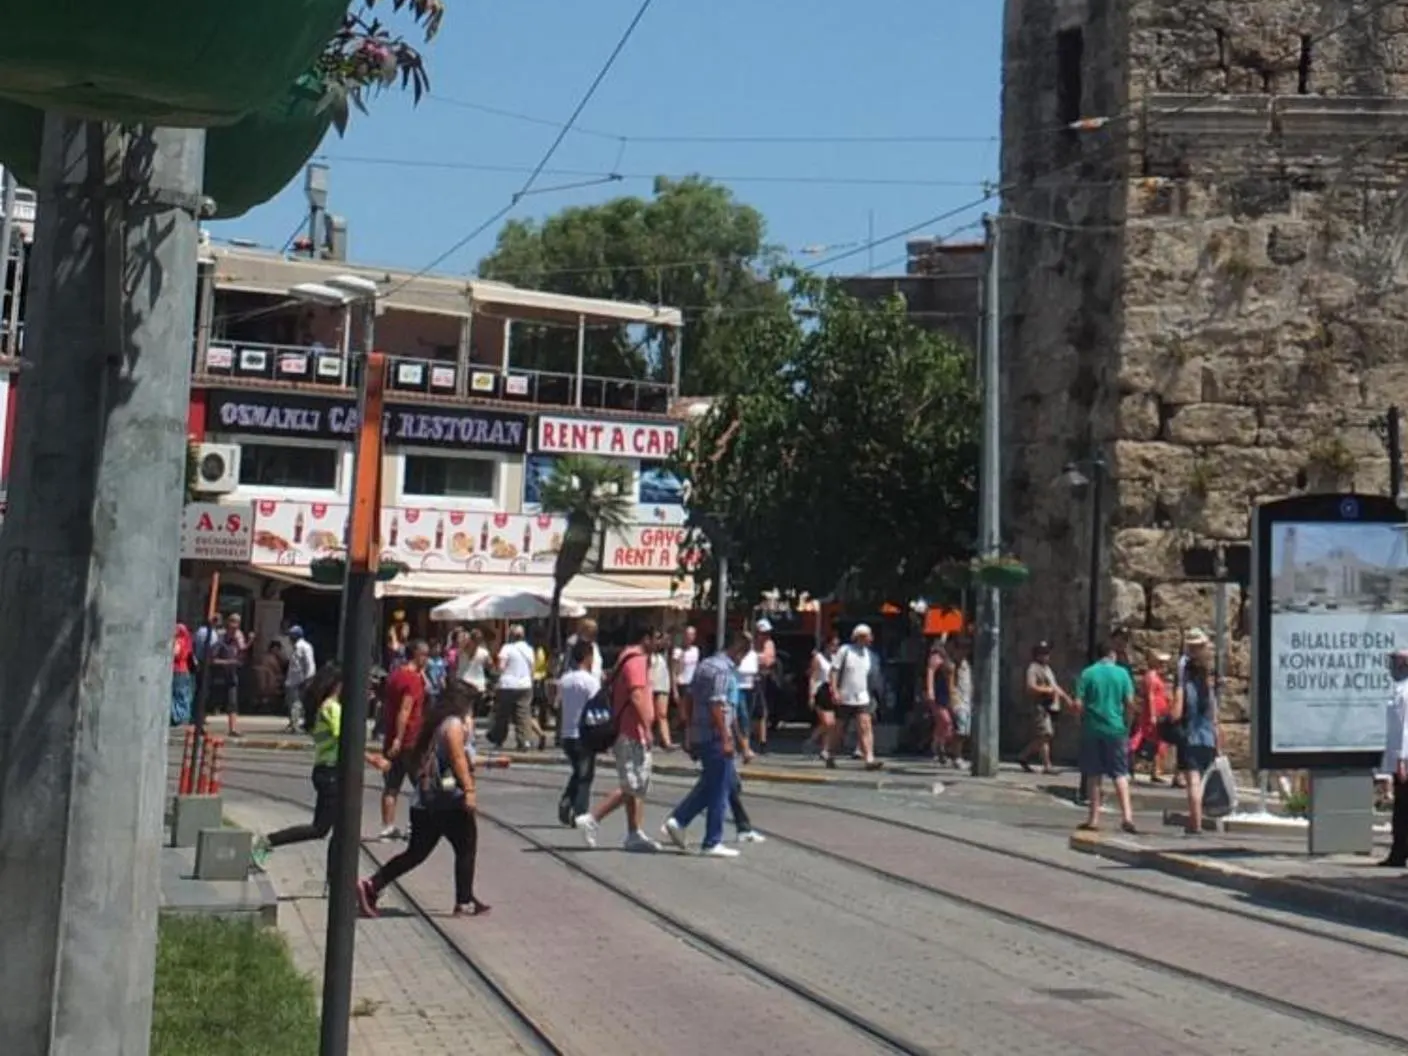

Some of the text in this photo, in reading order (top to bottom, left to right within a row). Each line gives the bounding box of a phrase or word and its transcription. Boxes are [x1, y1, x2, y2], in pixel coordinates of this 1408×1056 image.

[328, 406, 391, 438] CA
[397, 412, 524, 445] RESTORAN
[542, 421, 676, 455] RENT A CAR
[615, 546, 656, 567] RENT
[660, 548, 670, 567] A
[1287, 670, 1339, 690] BÜYÜK
